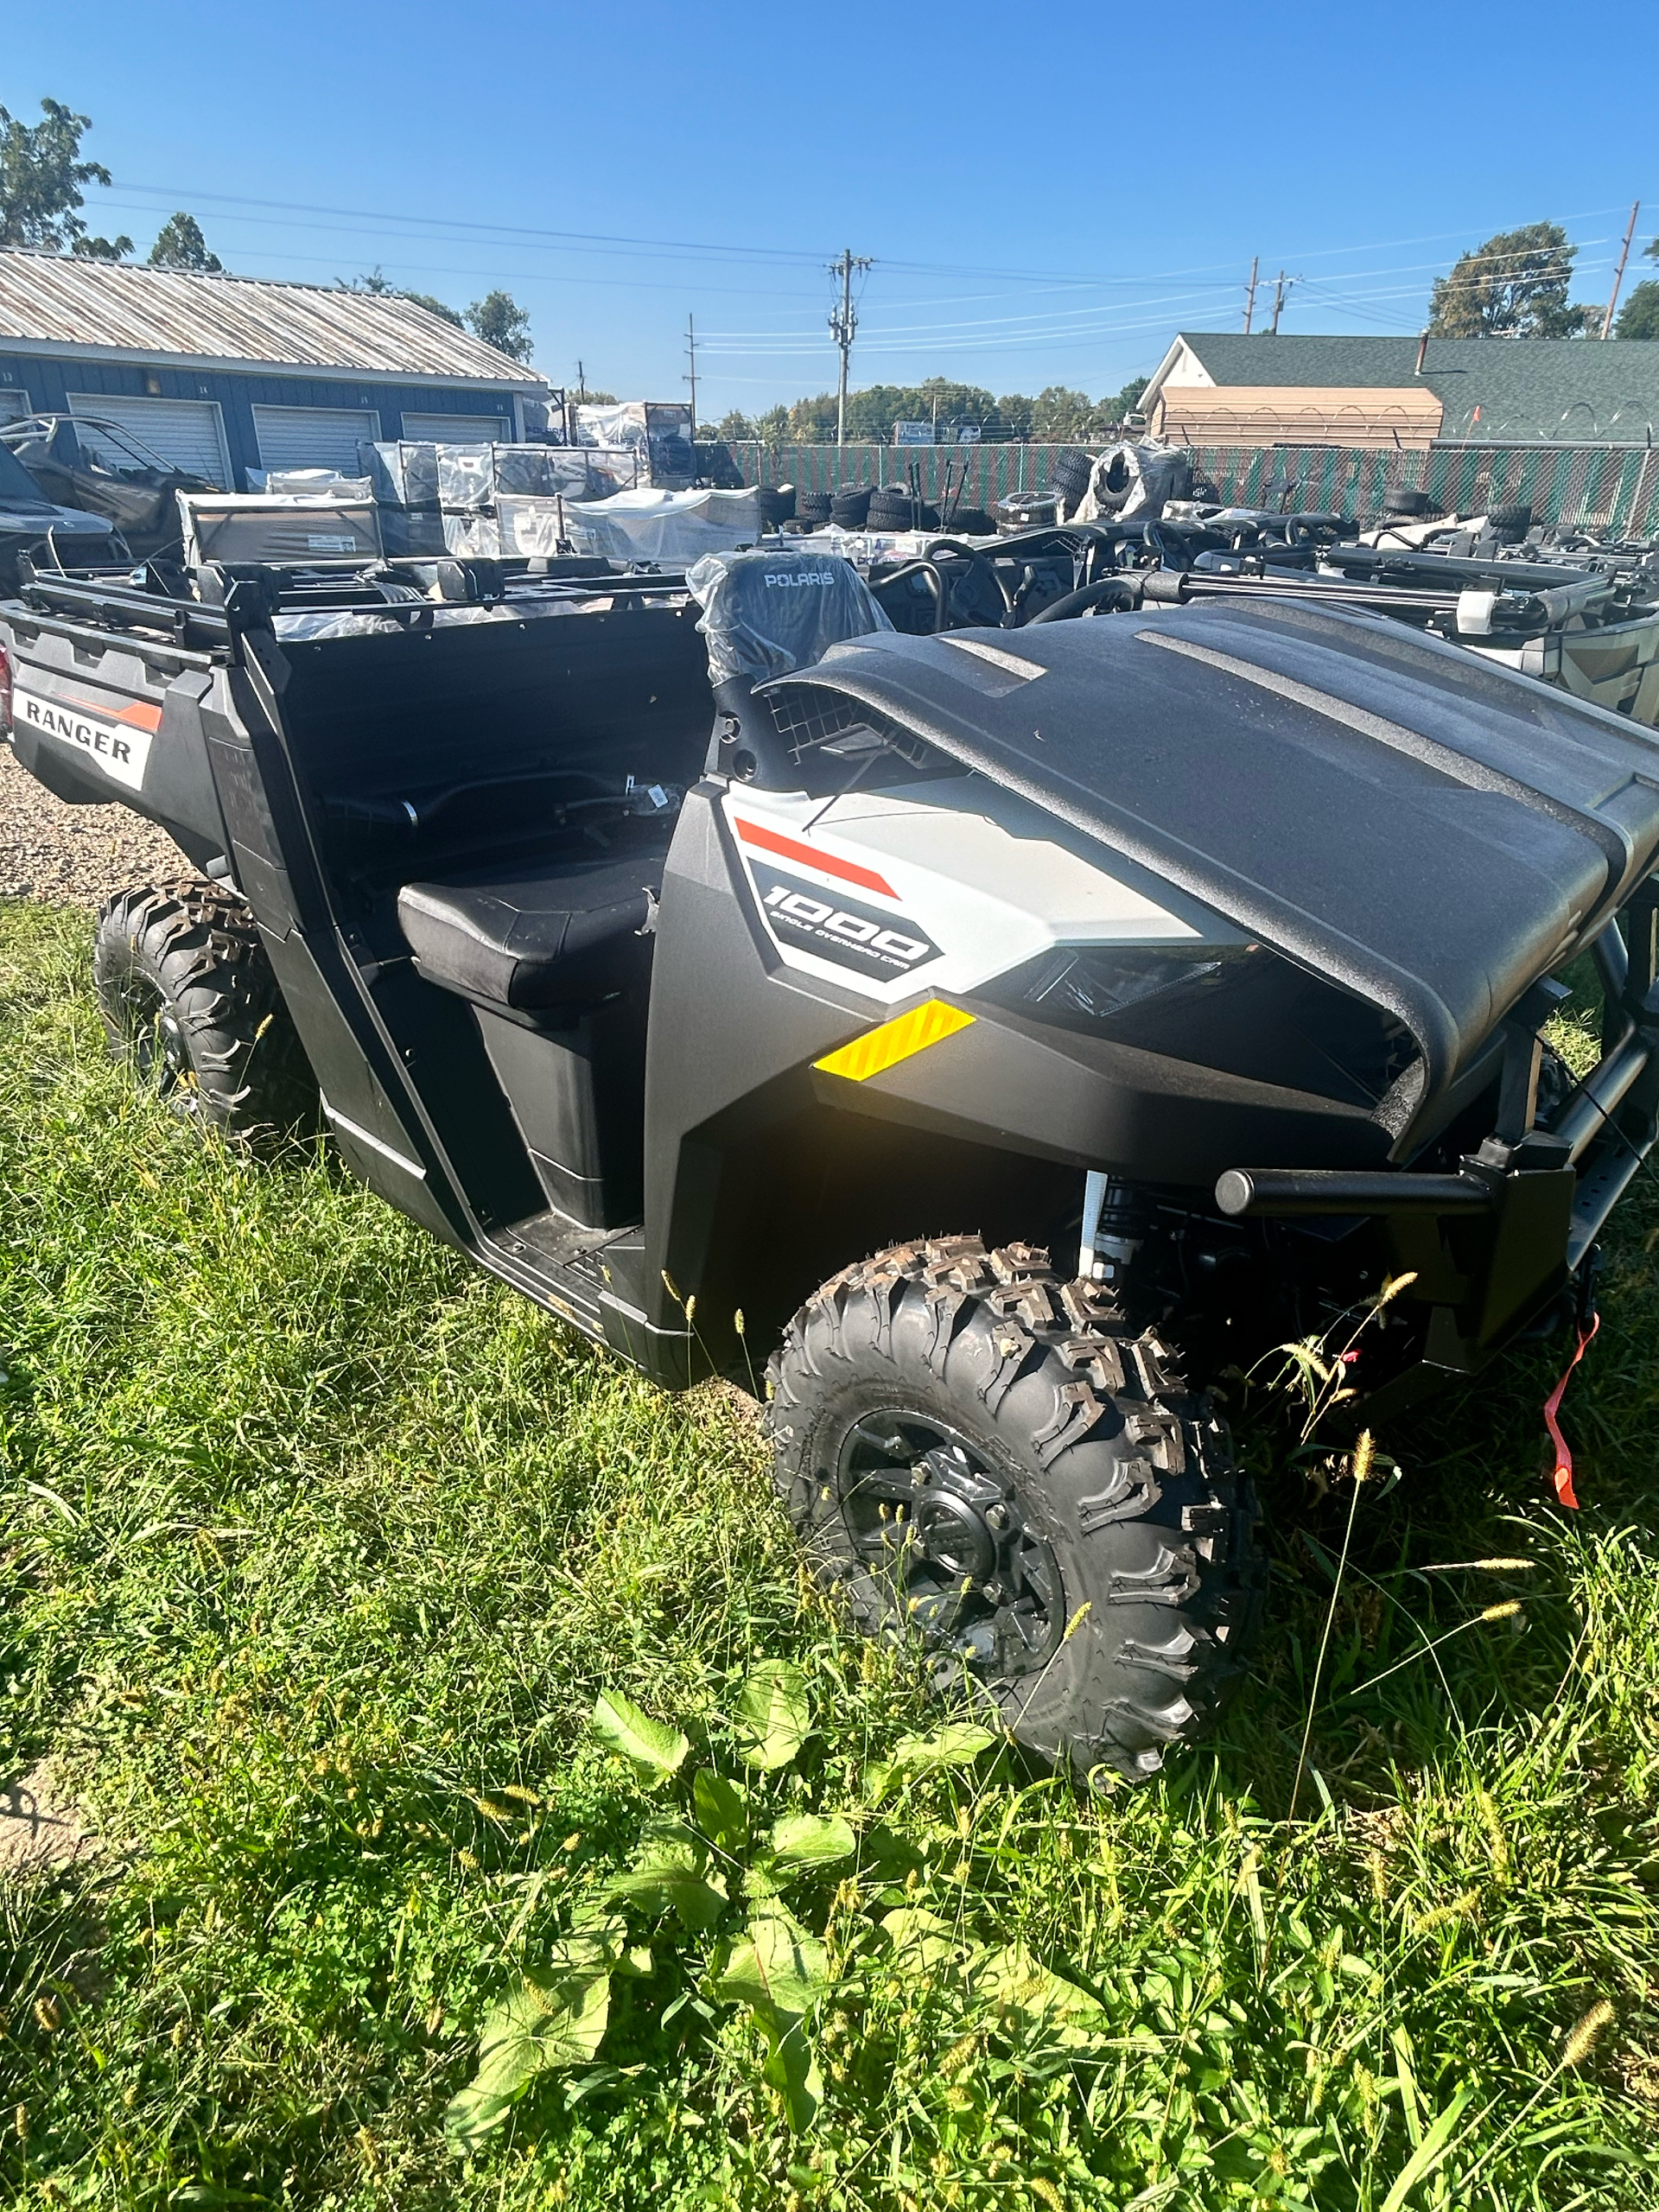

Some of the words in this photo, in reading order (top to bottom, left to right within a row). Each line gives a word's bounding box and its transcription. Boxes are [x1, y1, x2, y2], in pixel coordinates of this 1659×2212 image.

[764, 571, 836, 588] POLARIS
[27, 700, 130, 764] RANGER
[763, 885, 930, 961] 1000
[769, 911, 814, 931] SINGLE
[815, 929, 880, 958] OVERHEAD
[880, 955, 910, 969] CAM
